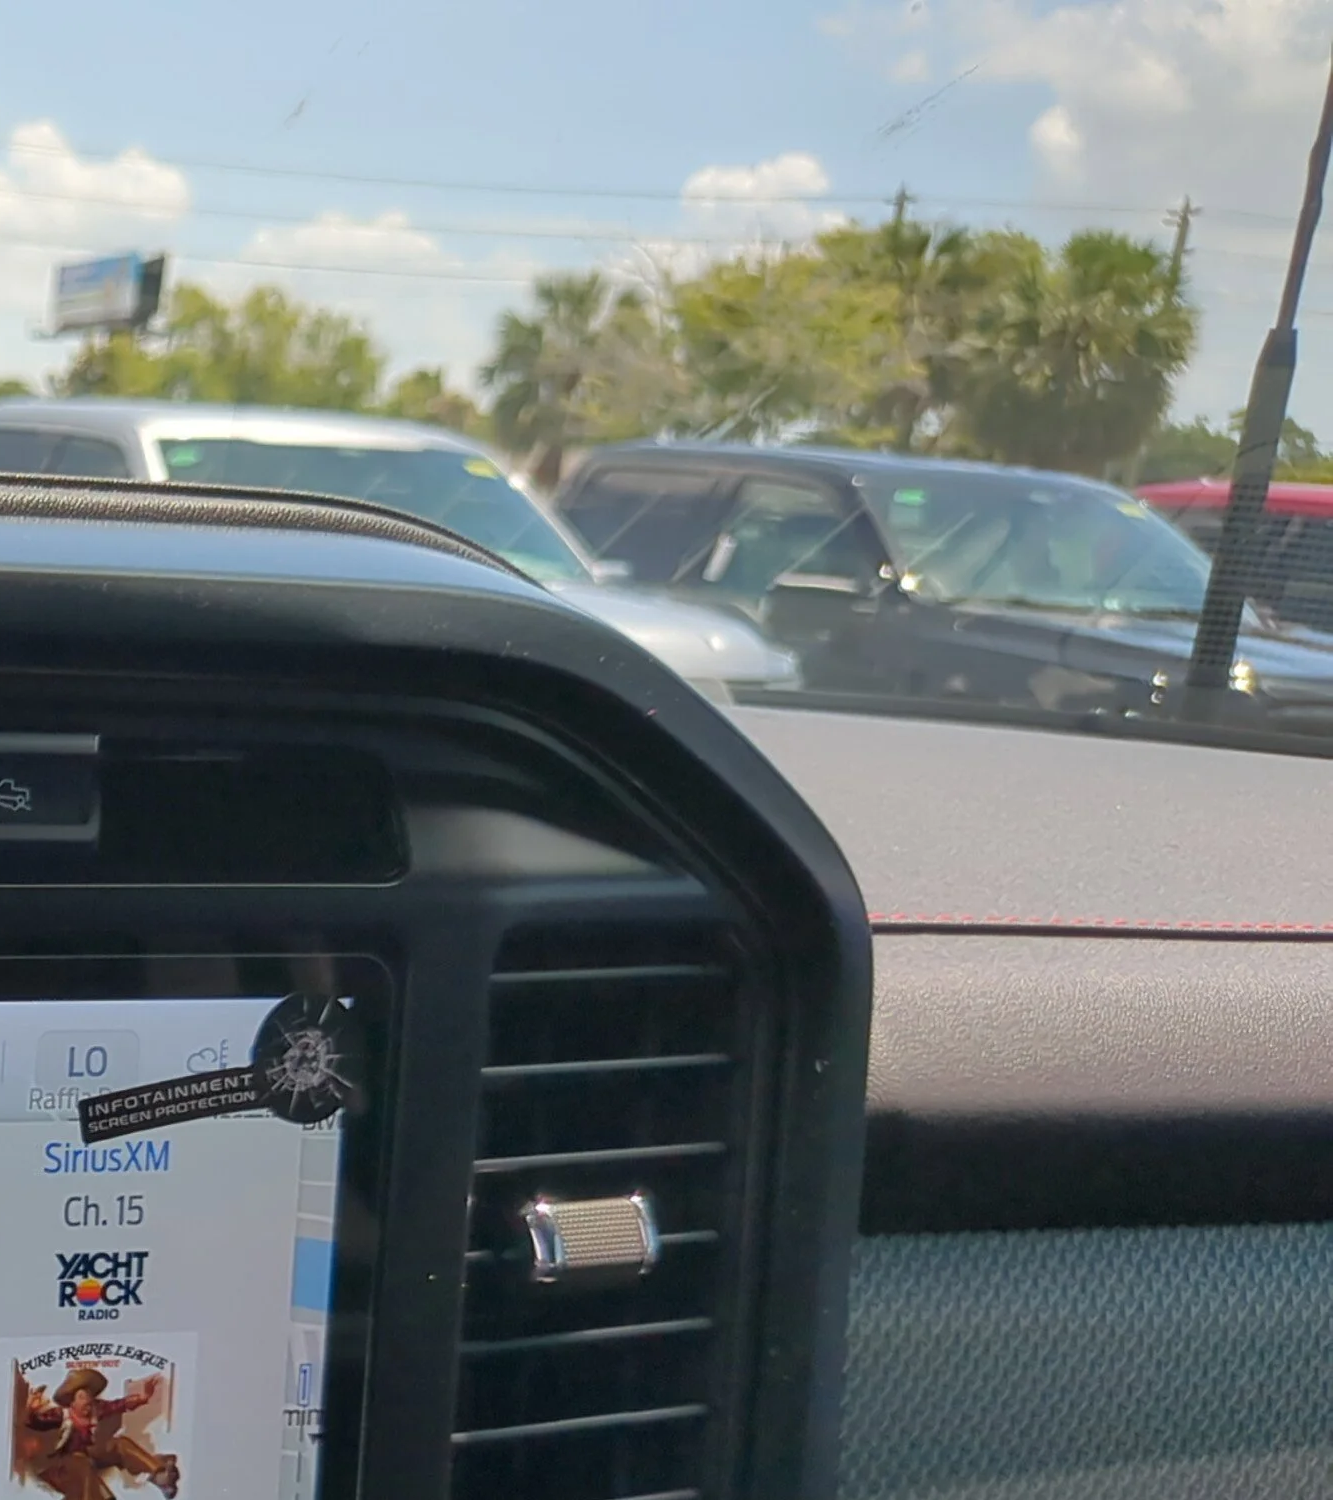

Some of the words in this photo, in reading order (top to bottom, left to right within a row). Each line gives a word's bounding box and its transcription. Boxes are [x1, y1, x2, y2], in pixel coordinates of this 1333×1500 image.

[67, 1046, 108, 1078] LO
[28, 1087, 85, 1111] Raffi
[87, 1072, 255, 1117] INFOTAINMENT
[87, 1110, 153, 1134] SCREEN
[154, 1089, 257, 1120] PROTECTION
[43, 1140, 170, 1175] SiriusXM
[63, 1195, 108, 1227] Ch.
[117, 1194, 144, 1226] 15
[55, 1250, 149, 1281] YACHT
[77, 1308, 119, 1321] RADIO
[20, 1350, 57, 1375] PURE
